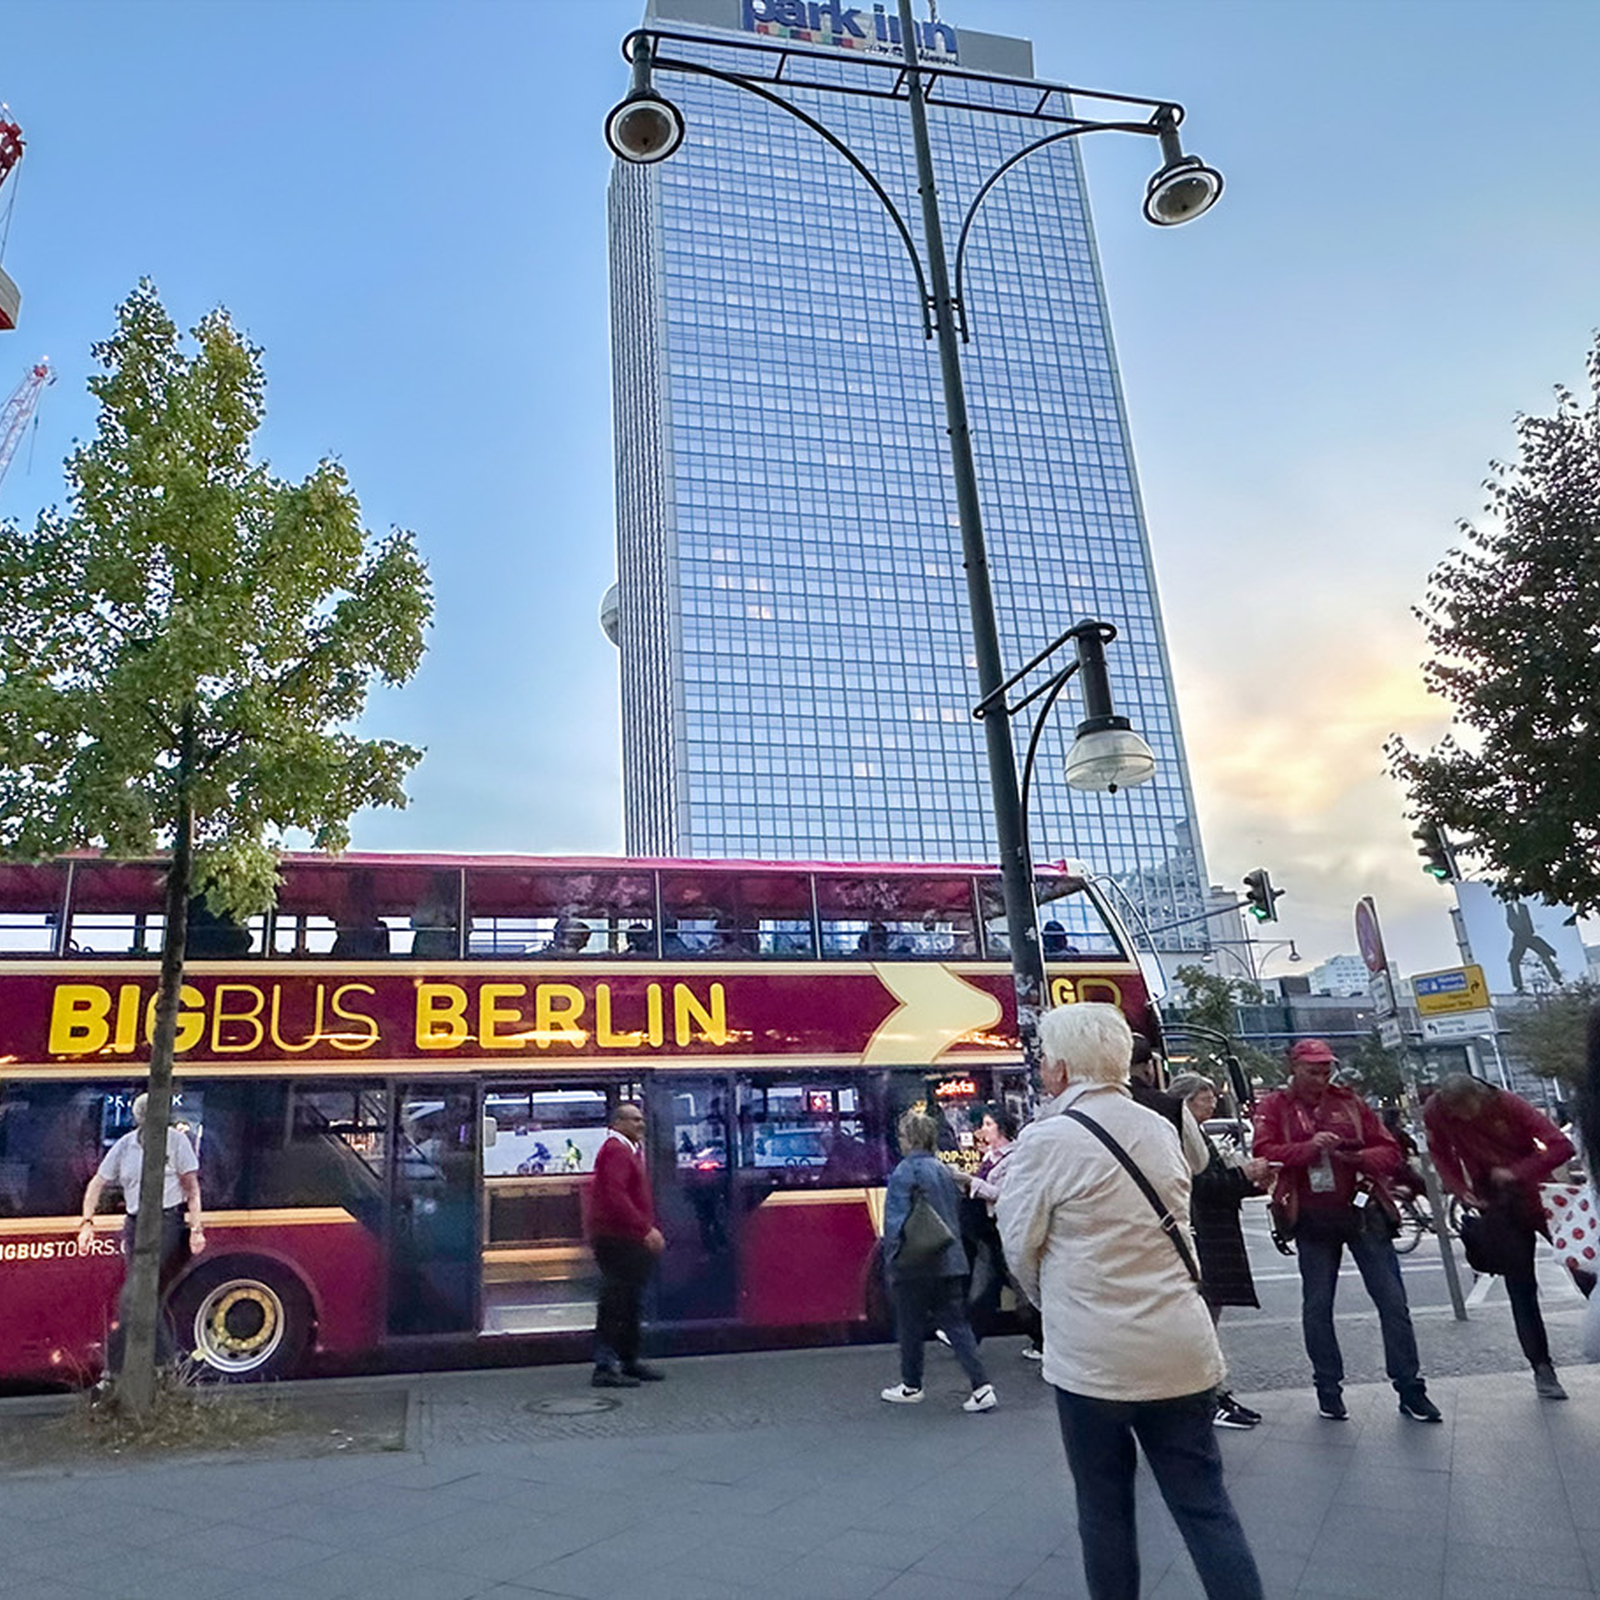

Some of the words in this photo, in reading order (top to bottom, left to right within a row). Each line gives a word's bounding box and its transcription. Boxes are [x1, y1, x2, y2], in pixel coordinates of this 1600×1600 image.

[742, 0, 866, 38] park
[48, 983, 378, 1054] BIGBUS
[415, 982, 727, 1050] BERLIN
